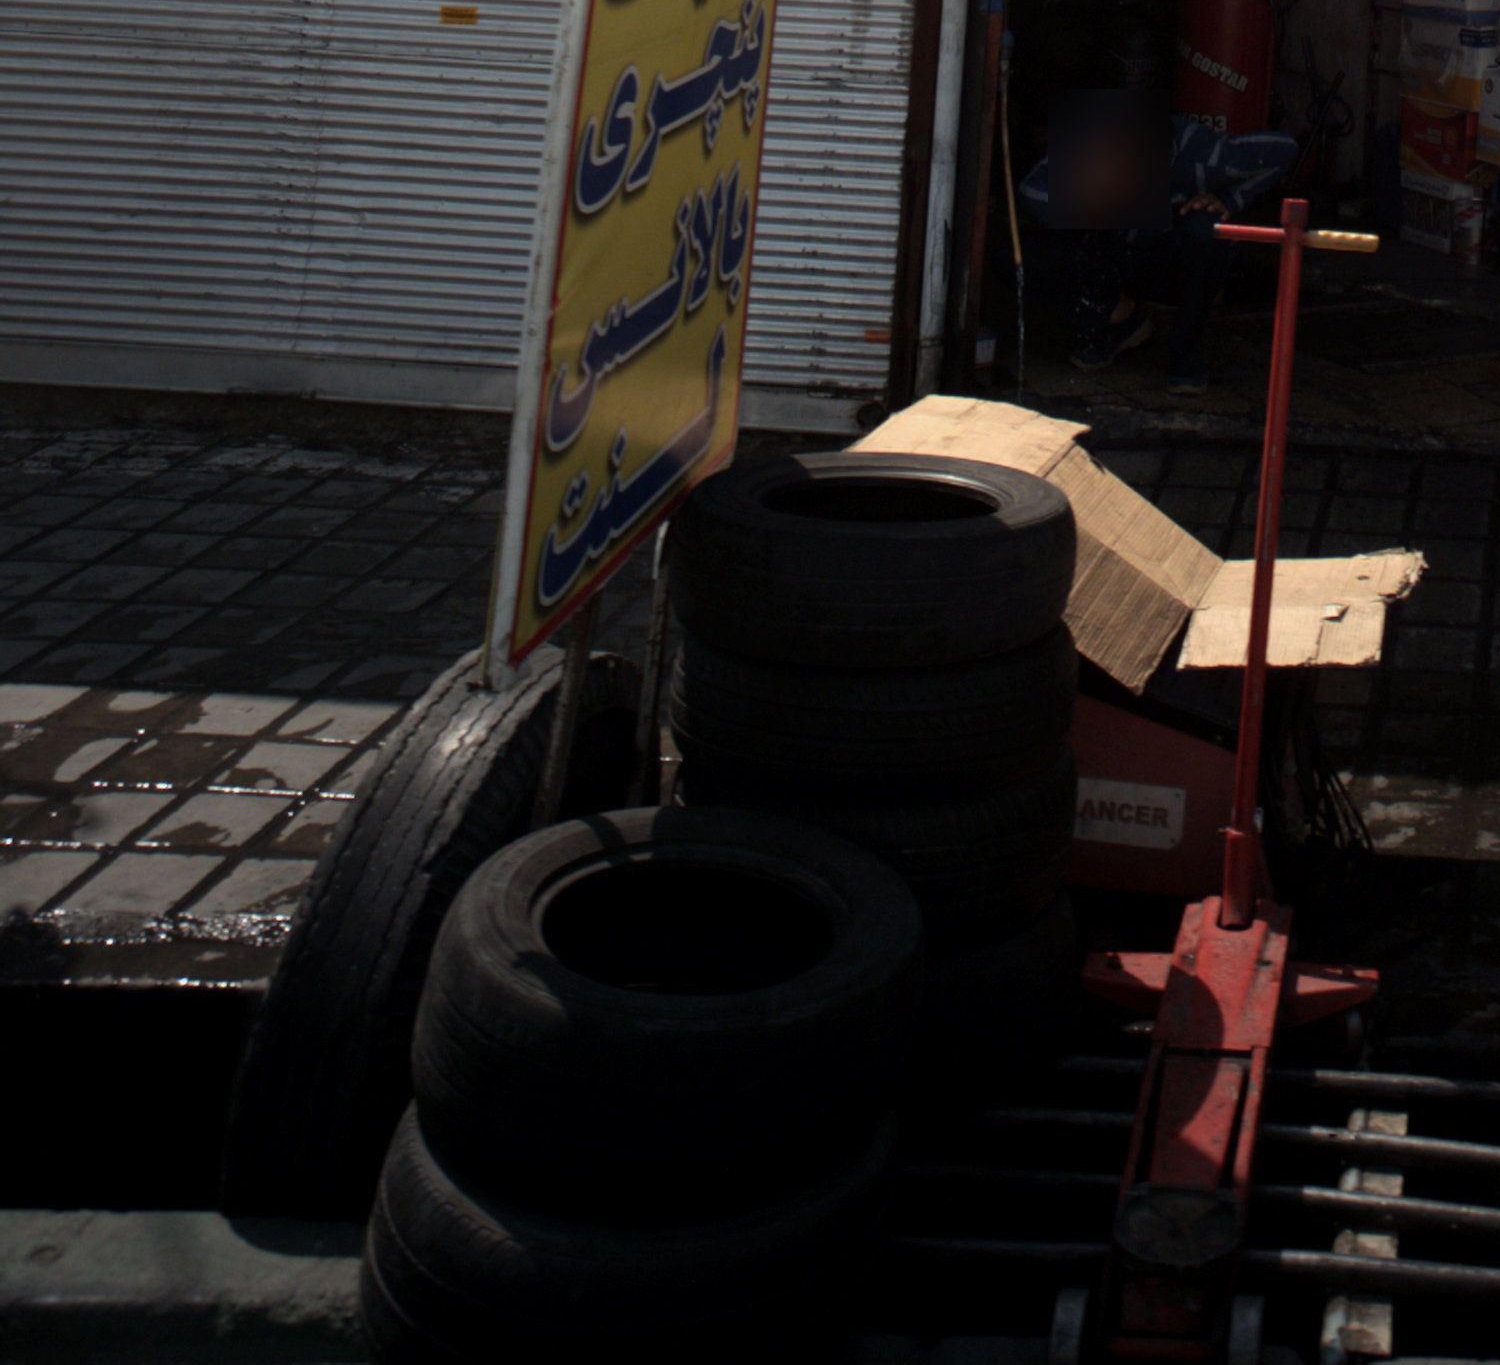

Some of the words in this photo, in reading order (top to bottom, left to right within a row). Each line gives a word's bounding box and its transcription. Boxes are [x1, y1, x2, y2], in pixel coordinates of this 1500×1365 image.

[1190, 50, 1250, 94] GOSTAR
[545, 161, 753, 453] بالانس
[537, 321, 729, 607] لنت
[1079, 798, 1170, 829] ANCER
